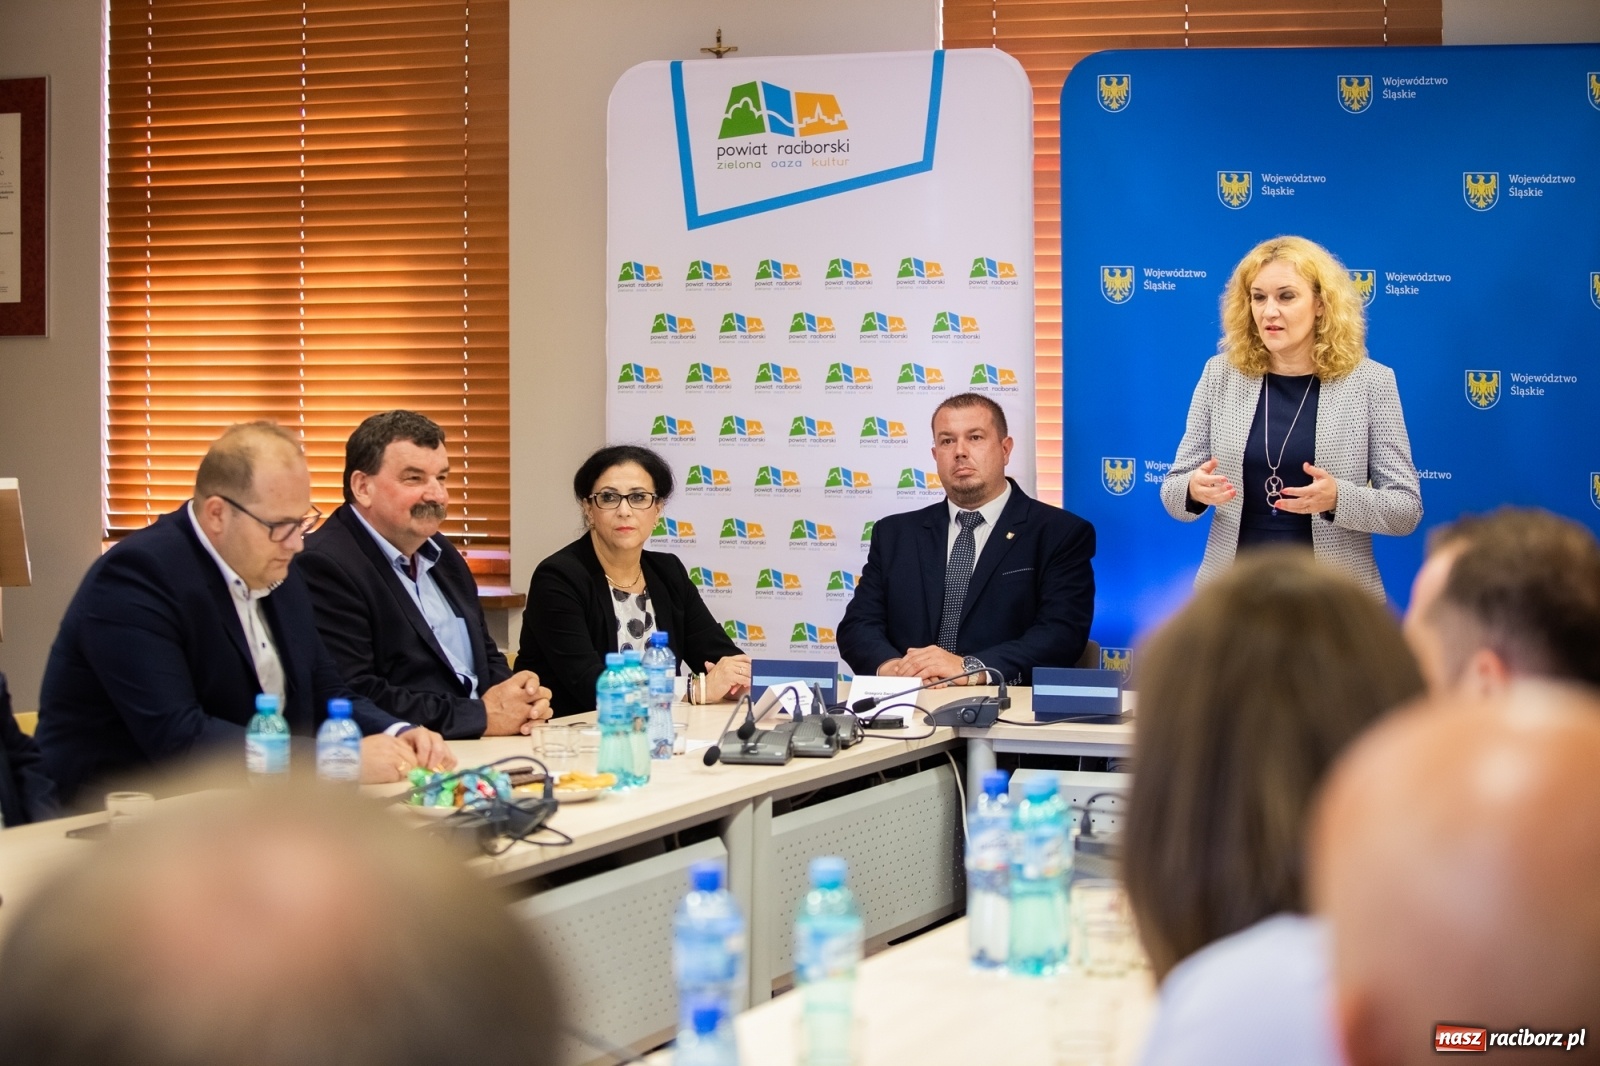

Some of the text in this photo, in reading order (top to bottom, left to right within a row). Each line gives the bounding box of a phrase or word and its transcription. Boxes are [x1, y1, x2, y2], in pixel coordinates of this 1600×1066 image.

[1382, 76, 1448, 87] Województwo
[1382, 89, 1416, 100] Śląskie
[717, 139, 850, 160] powiat raciborski
[717, 157, 849, 169] zielona oaza kultur
[1261, 173, 1326, 184] Województwo
[1508, 174, 1576, 185] Województwo
[1261, 185, 1295, 197] Śląskie
[1508, 186, 1543, 198] Śląskie
[1143, 268, 1207, 279] Województwo
[1385, 272, 1452, 283] Województwo
[1143, 279, 1176, 292] Śląskie
[1385, 283, 1420, 296] Śląskie
[1510, 373, 1577, 384] Województwo
[1510, 384, 1545, 397] Śląskie
[1417, 469, 1452, 479] ództwo
[719, 538, 737, 546] powiat
[790, 643, 808, 651] powiat
